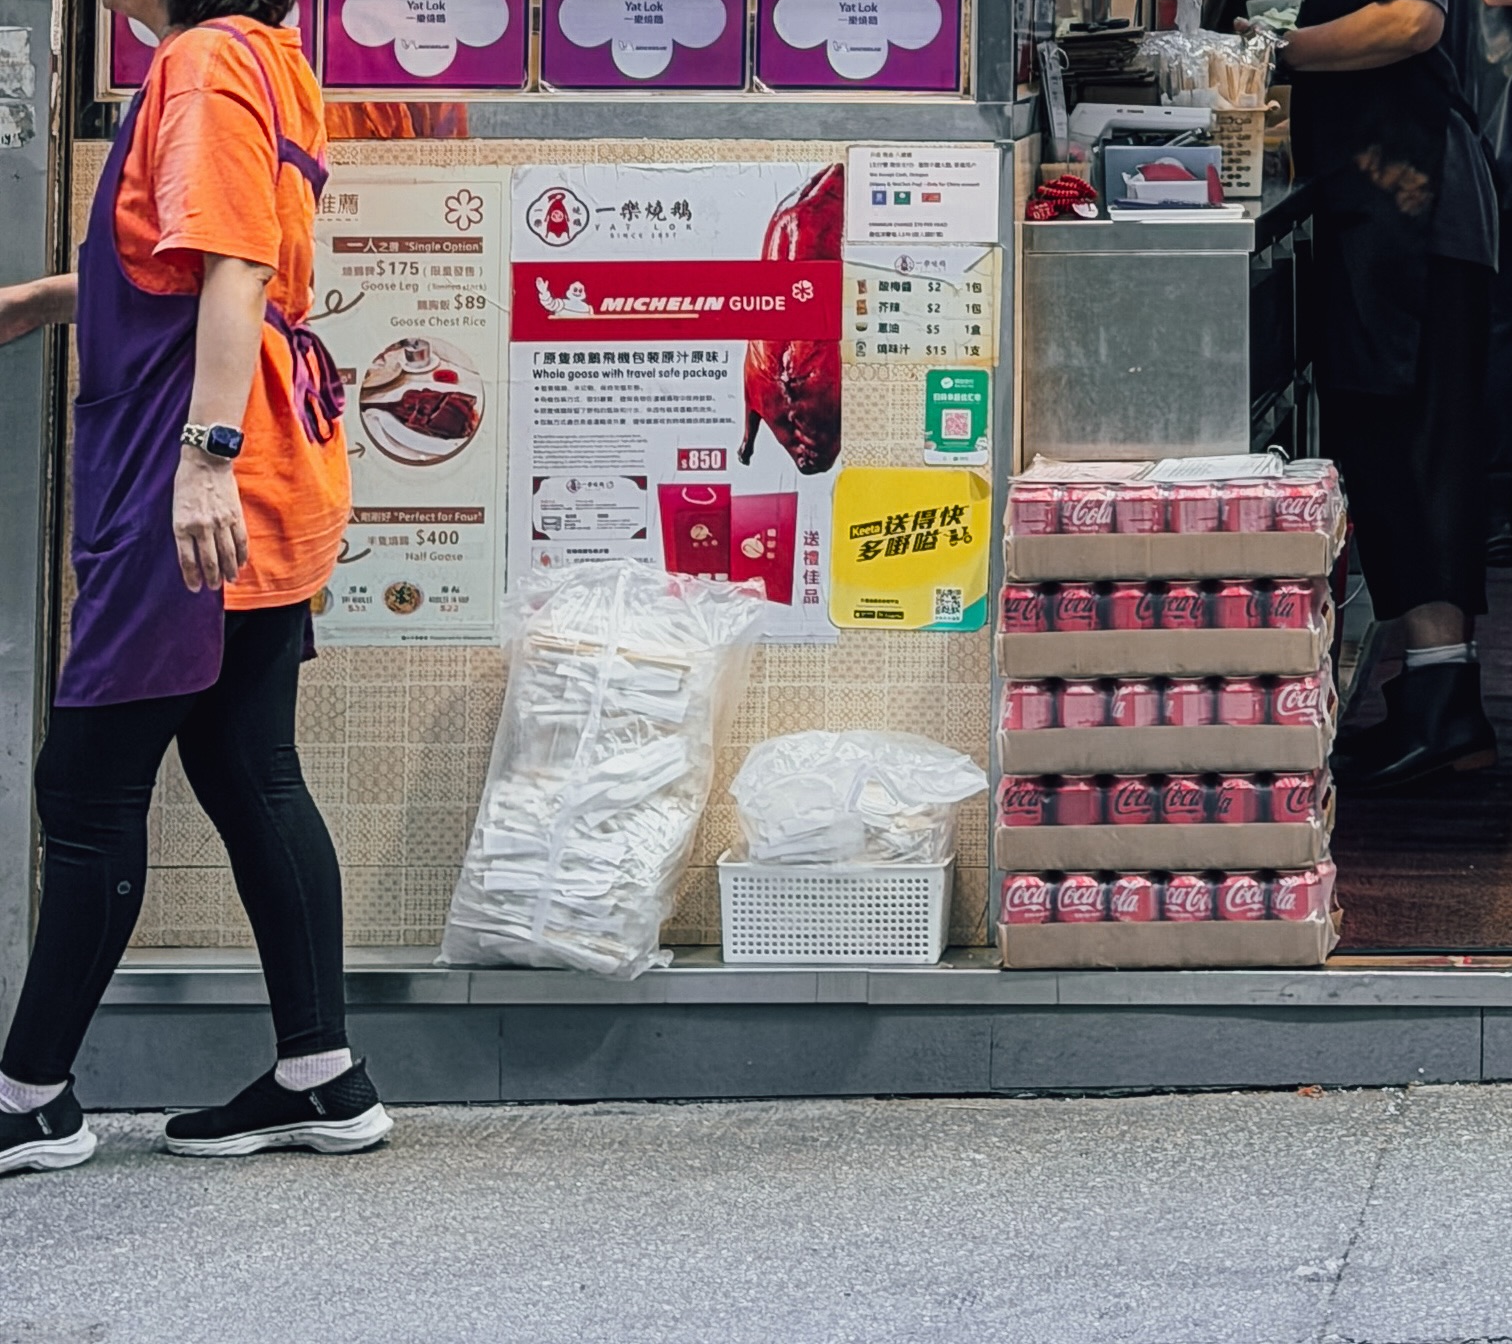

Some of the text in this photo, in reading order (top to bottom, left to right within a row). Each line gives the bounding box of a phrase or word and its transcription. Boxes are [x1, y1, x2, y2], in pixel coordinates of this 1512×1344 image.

[407, 0, 446, 11] Yat Lok
[625, 1, 663, 12] Yat Lok
[839, 2, 878, 13] Yat Lok
[361, 281, 419, 292] Goose Leg
[928, 282, 941, 292] $2
[454, 294, 486, 310] $89
[600, 296, 785, 312] MICHELIN GUIDE
[927, 303, 940, 313] $2
[390, 316, 486, 326] Goose Chest Rice
[926, 324, 940, 334] $5
[926, 345, 947, 356] $15
[533, 367, 727, 382] Whole goose with travel safe package
[681, 450, 721, 469] $850
[852, 504, 970, 536] Keeta 送得快
[416, 529, 459, 546] $400
